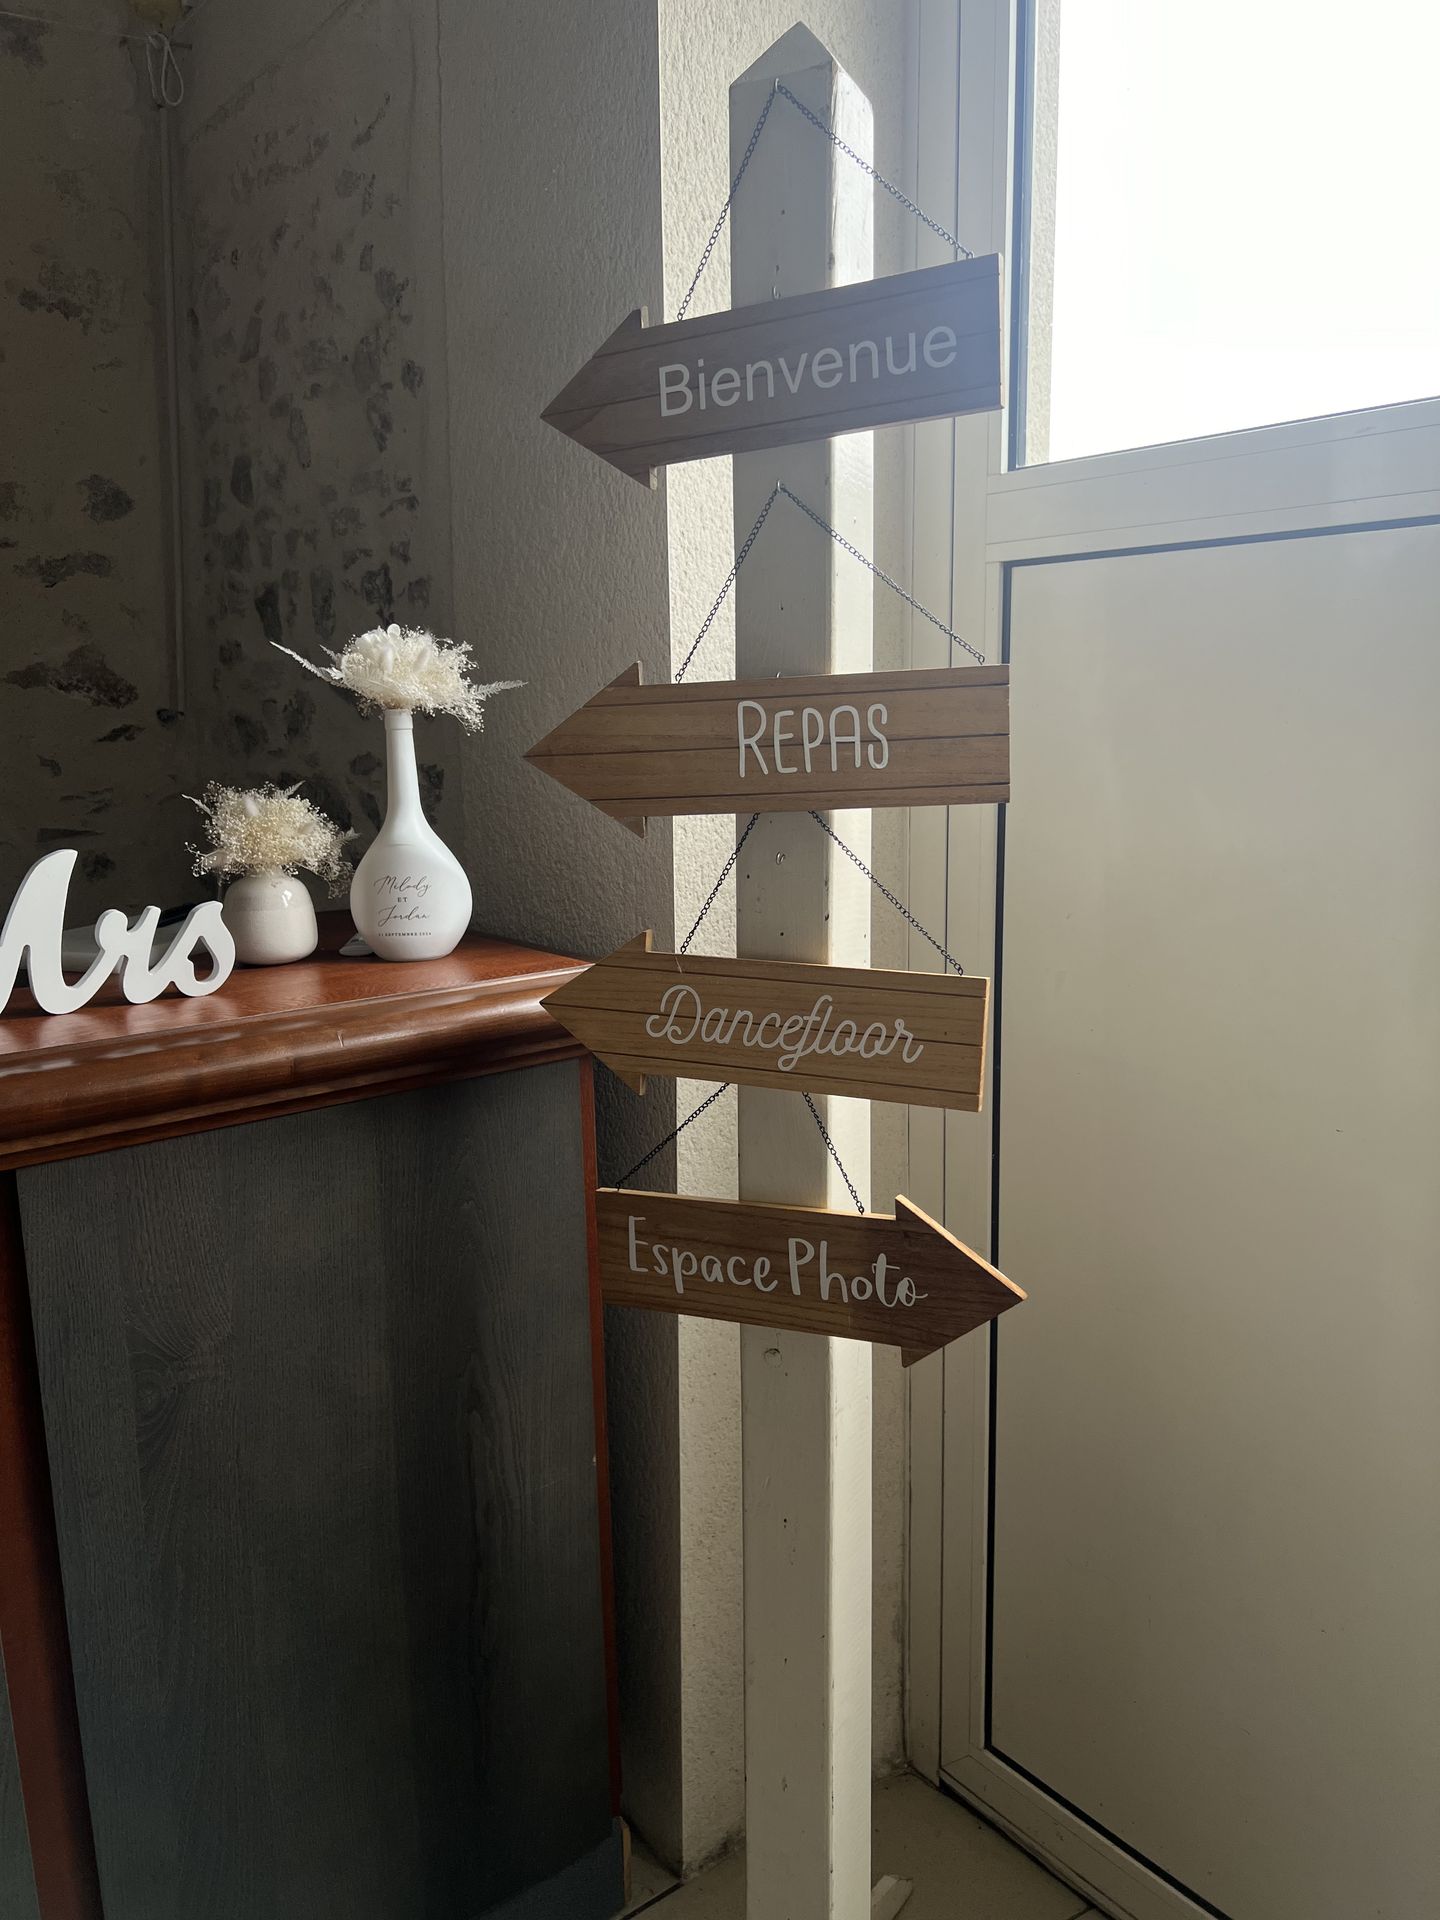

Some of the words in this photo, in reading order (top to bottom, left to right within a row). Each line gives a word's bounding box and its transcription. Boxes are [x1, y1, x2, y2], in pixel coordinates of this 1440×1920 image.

[658, 326, 957, 417] Bienvenue
[737, 700, 889, 778] REPAS
[378, 905, 430, 928] Jordan
[645, 984, 924, 1072] Dancefloor
[628, 1215, 778, 1294] Espace
[788, 1238, 929, 1308] Photo
